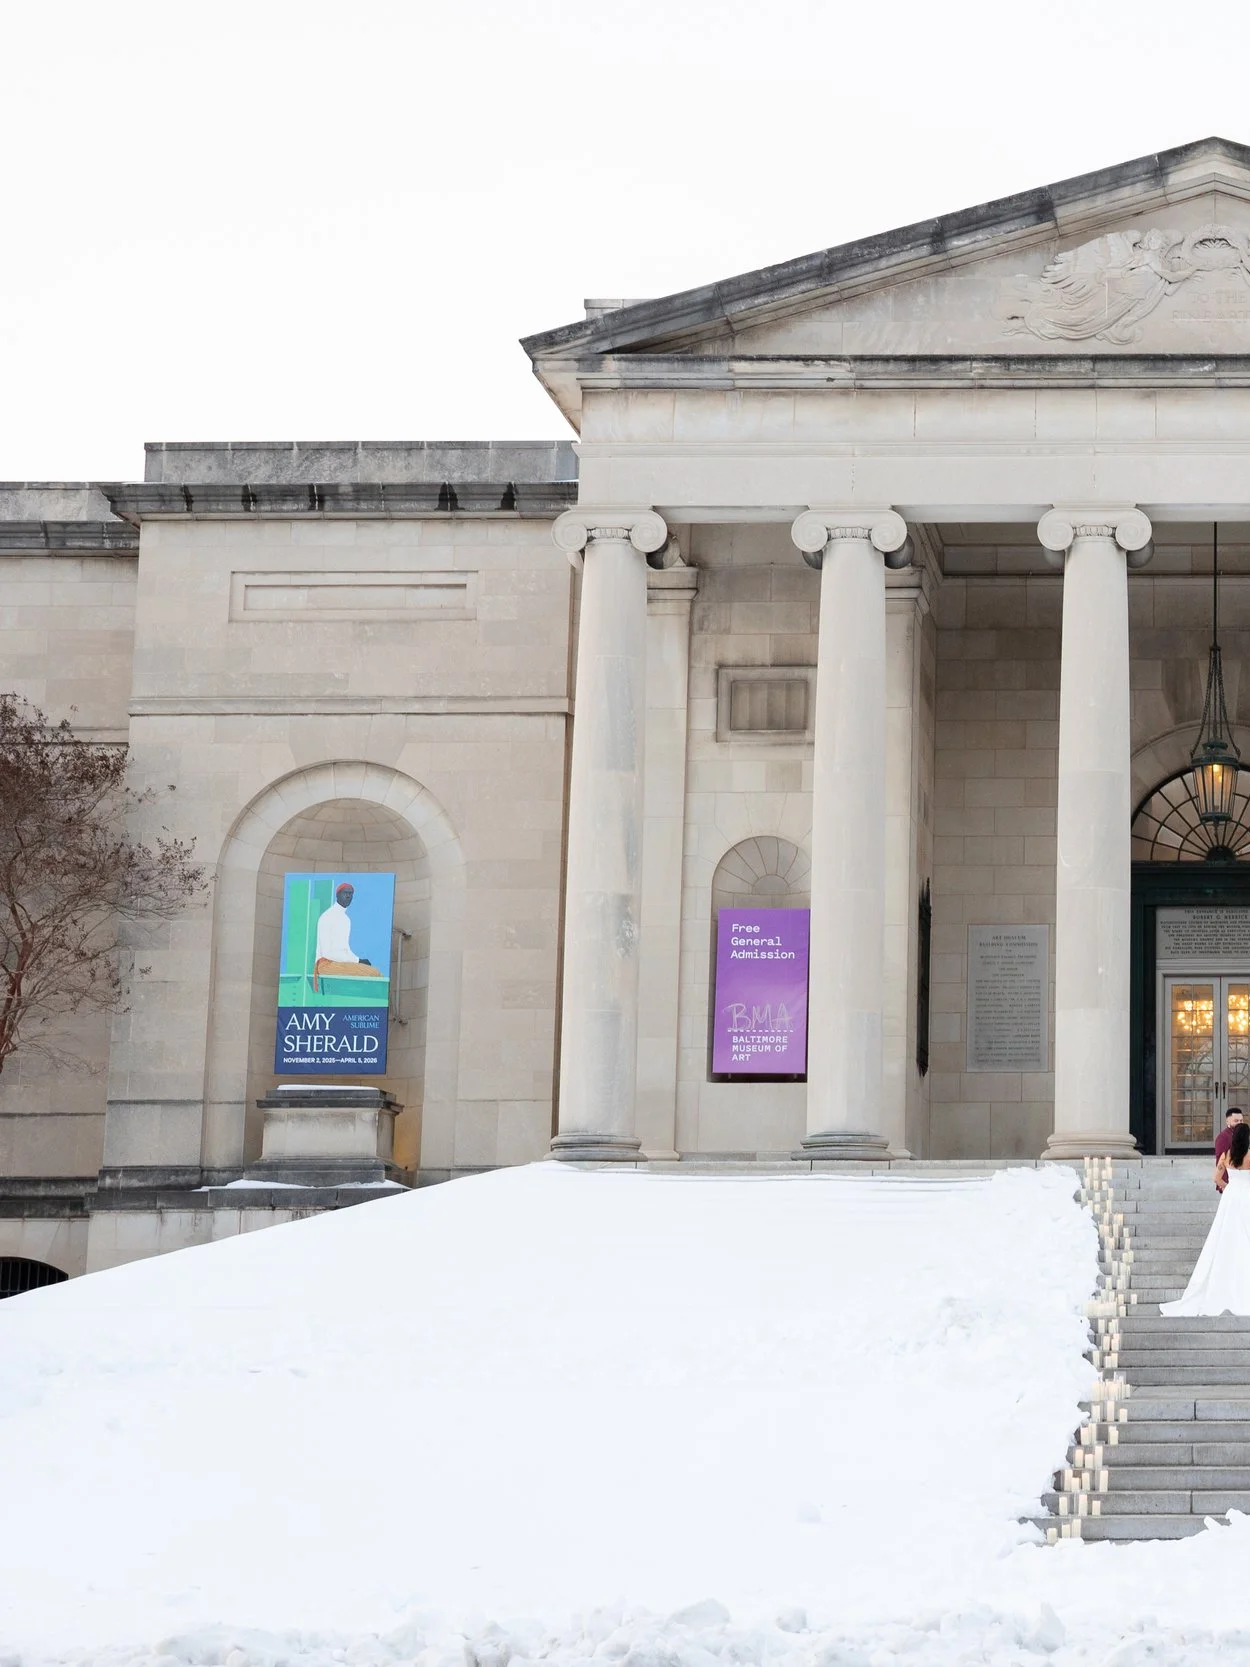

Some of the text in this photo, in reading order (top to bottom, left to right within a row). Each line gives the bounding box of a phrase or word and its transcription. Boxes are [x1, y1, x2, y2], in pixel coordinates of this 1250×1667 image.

[731, 923, 760, 933] Free
[731, 936, 782, 946] General
[730, 949, 795, 959] Admission
[285, 1013, 336, 1031] AMY
[723, 1003, 793, 1031] BMA
[283, 1035, 379, 1053] SHERALD
[732, 1035, 788, 1043] BALTIMORE
[732, 1044, 788, 1052] MUSEUM OF
[732, 1053, 751, 1062] ART
